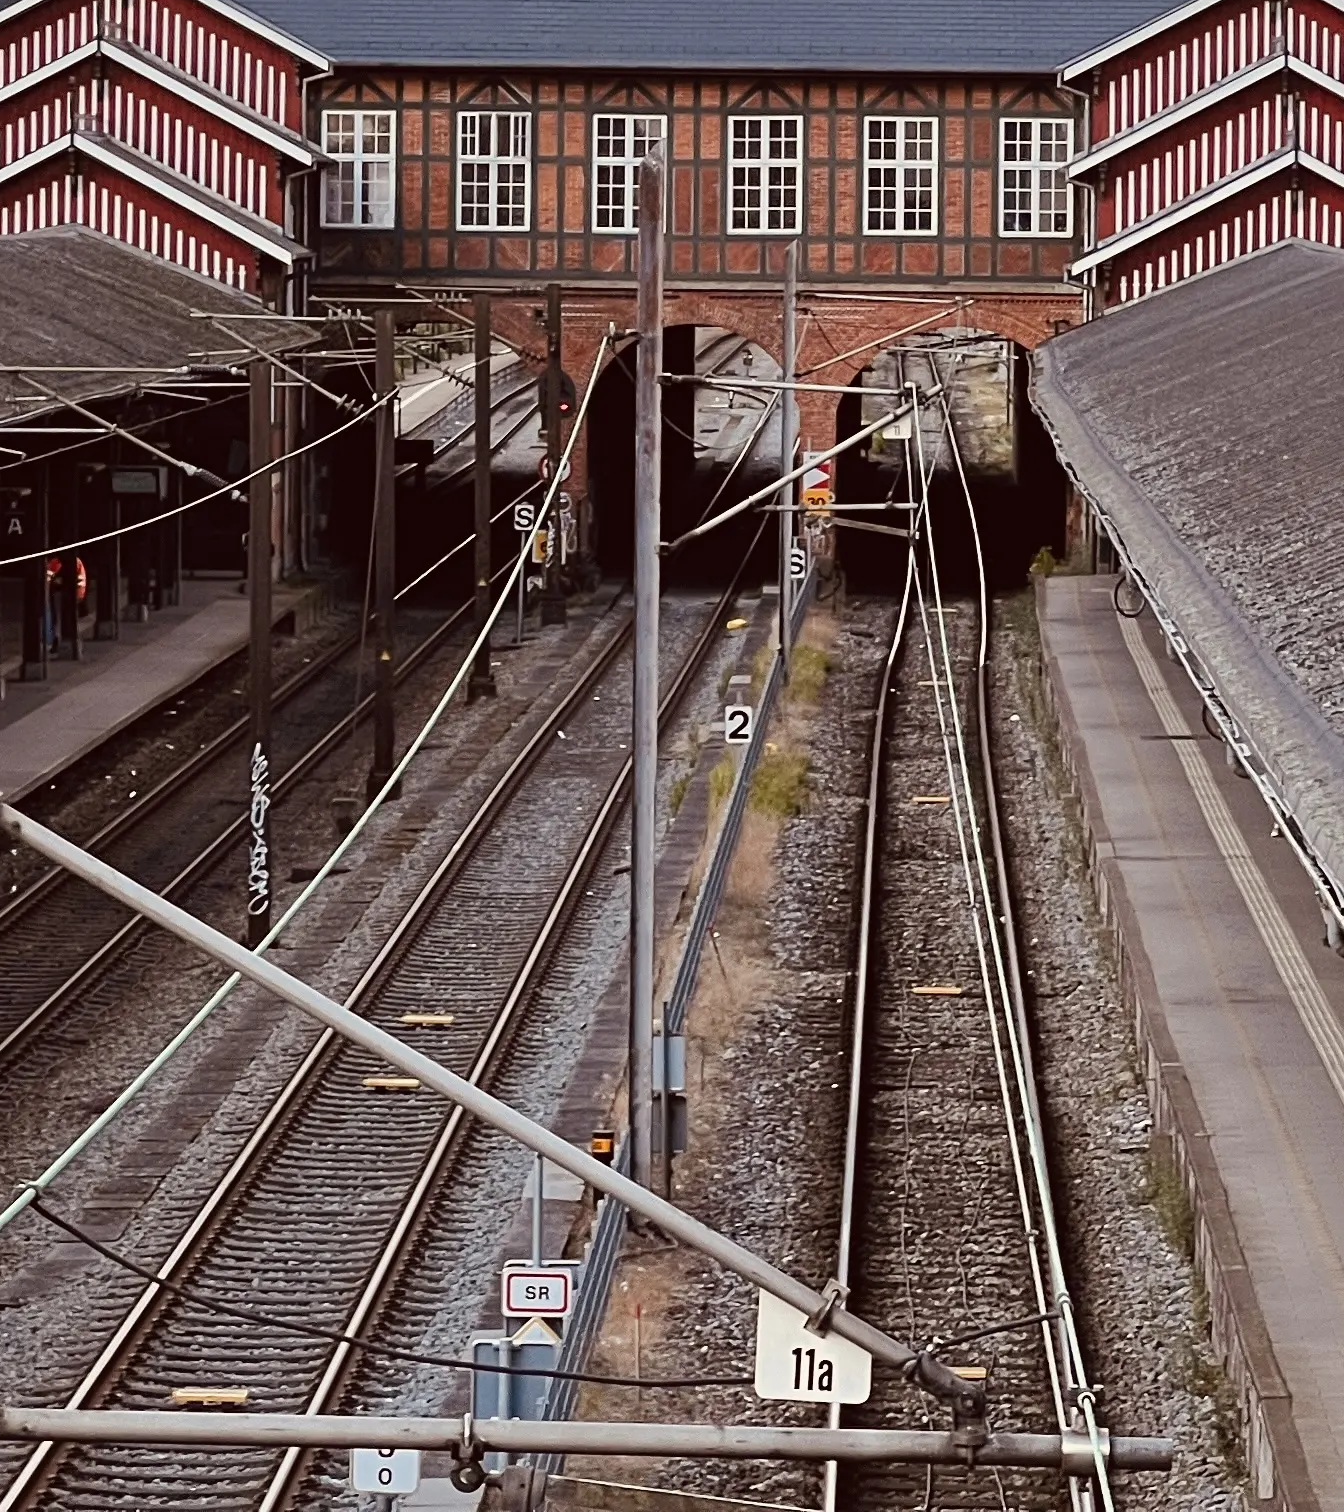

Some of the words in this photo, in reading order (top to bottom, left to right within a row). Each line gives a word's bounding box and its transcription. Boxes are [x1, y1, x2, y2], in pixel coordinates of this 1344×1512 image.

[7, 518, 23, 535] A
[516, 507, 533, 528] S
[790, 553, 804, 575] S
[728, 710, 749, 739] 2
[525, 1285, 551, 1300] SR
[791, 1347, 834, 1392] 11a
